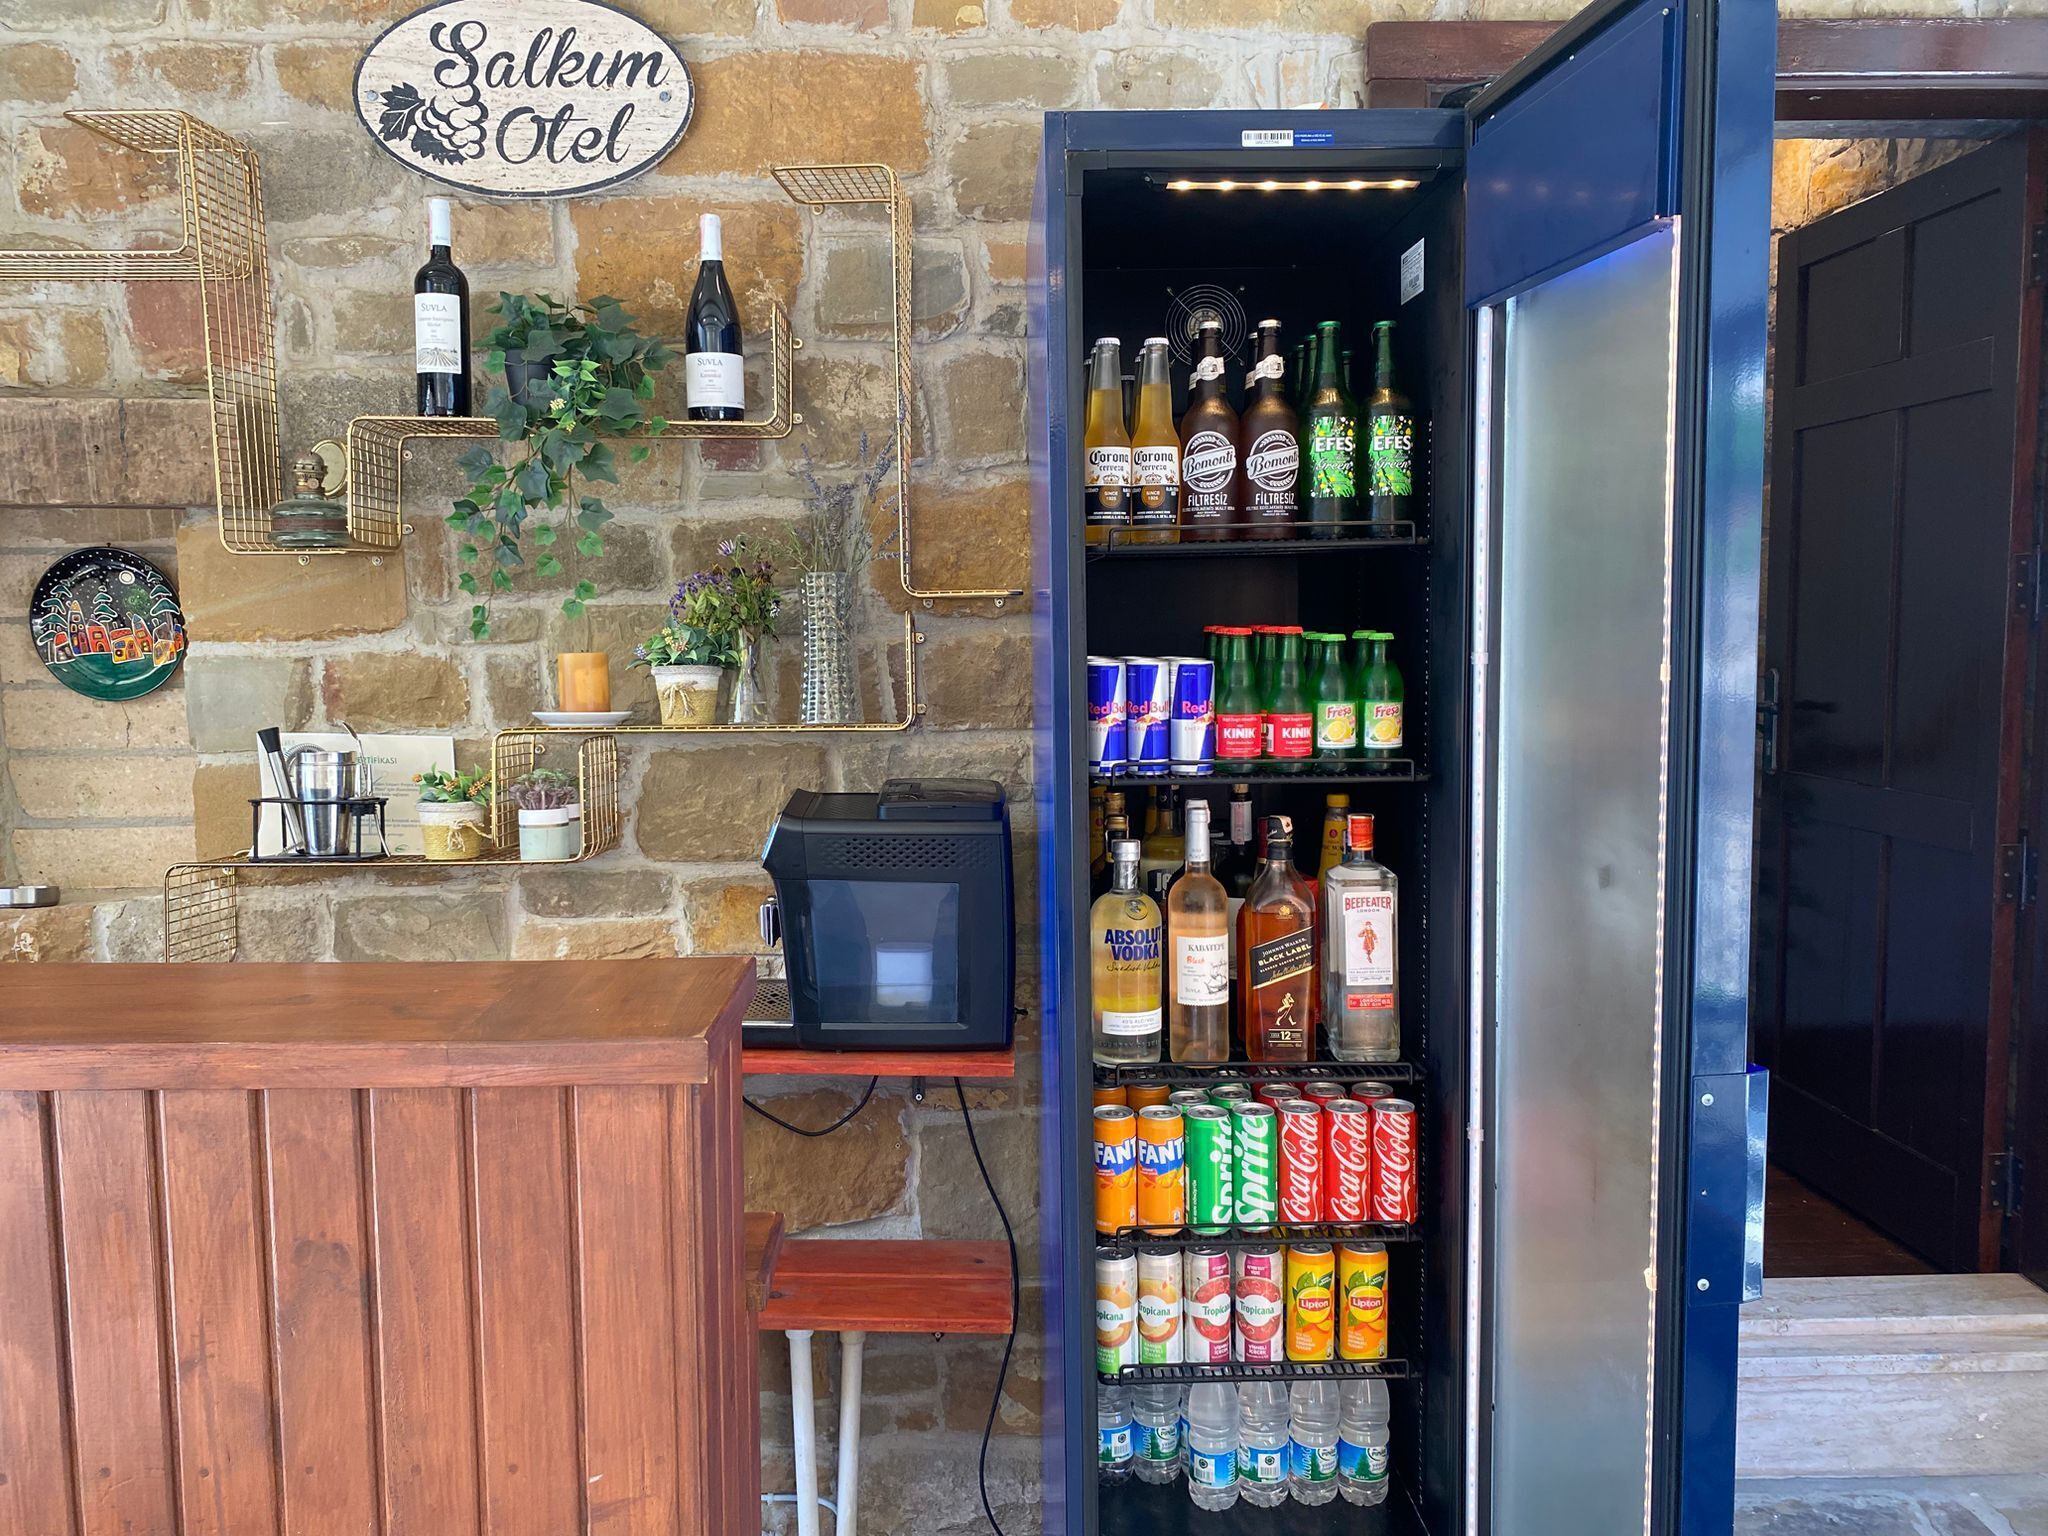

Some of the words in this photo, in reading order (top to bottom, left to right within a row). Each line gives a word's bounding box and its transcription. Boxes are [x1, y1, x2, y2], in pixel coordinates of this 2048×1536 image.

[496, 103, 635, 164] Otel
[1315, 436, 1353, 452] EFES
[1373, 435, 1412, 451] EFES
[1089, 449, 1129, 465] Corona
[1133, 449, 1175, 465] Corona
[1184, 450, 1234, 480] Bomonti
[1250, 449, 1298, 479] Bomonti
[1188, 492, 1228, 506] FİLTRESİZ
[1255, 491, 1295, 505] FİLTRESİZ
[1128, 701, 1148, 714] Red
[1150, 702, 1168, 714] Bull
[1182, 701, 1207, 713] Red
[1223, 727, 1256, 739] KINIK
[1344, 896, 1392, 911] BEEFEATER
[1104, 926, 1162, 946] ABSOLUT
[1111, 945, 1160, 961] VODKA
[1258, 952, 1285, 967] BLACK
[1285, 943, 1313, 957] LABEL
[1280, 1031, 1292, 1041] 12
[1233, 1115, 1274, 1224] Sprite
[1239, 1301, 1275, 1315] Tropicana
[1301, 1299, 1329, 1310] Lipton
[1352, 1298, 1380, 1308] Lipton
